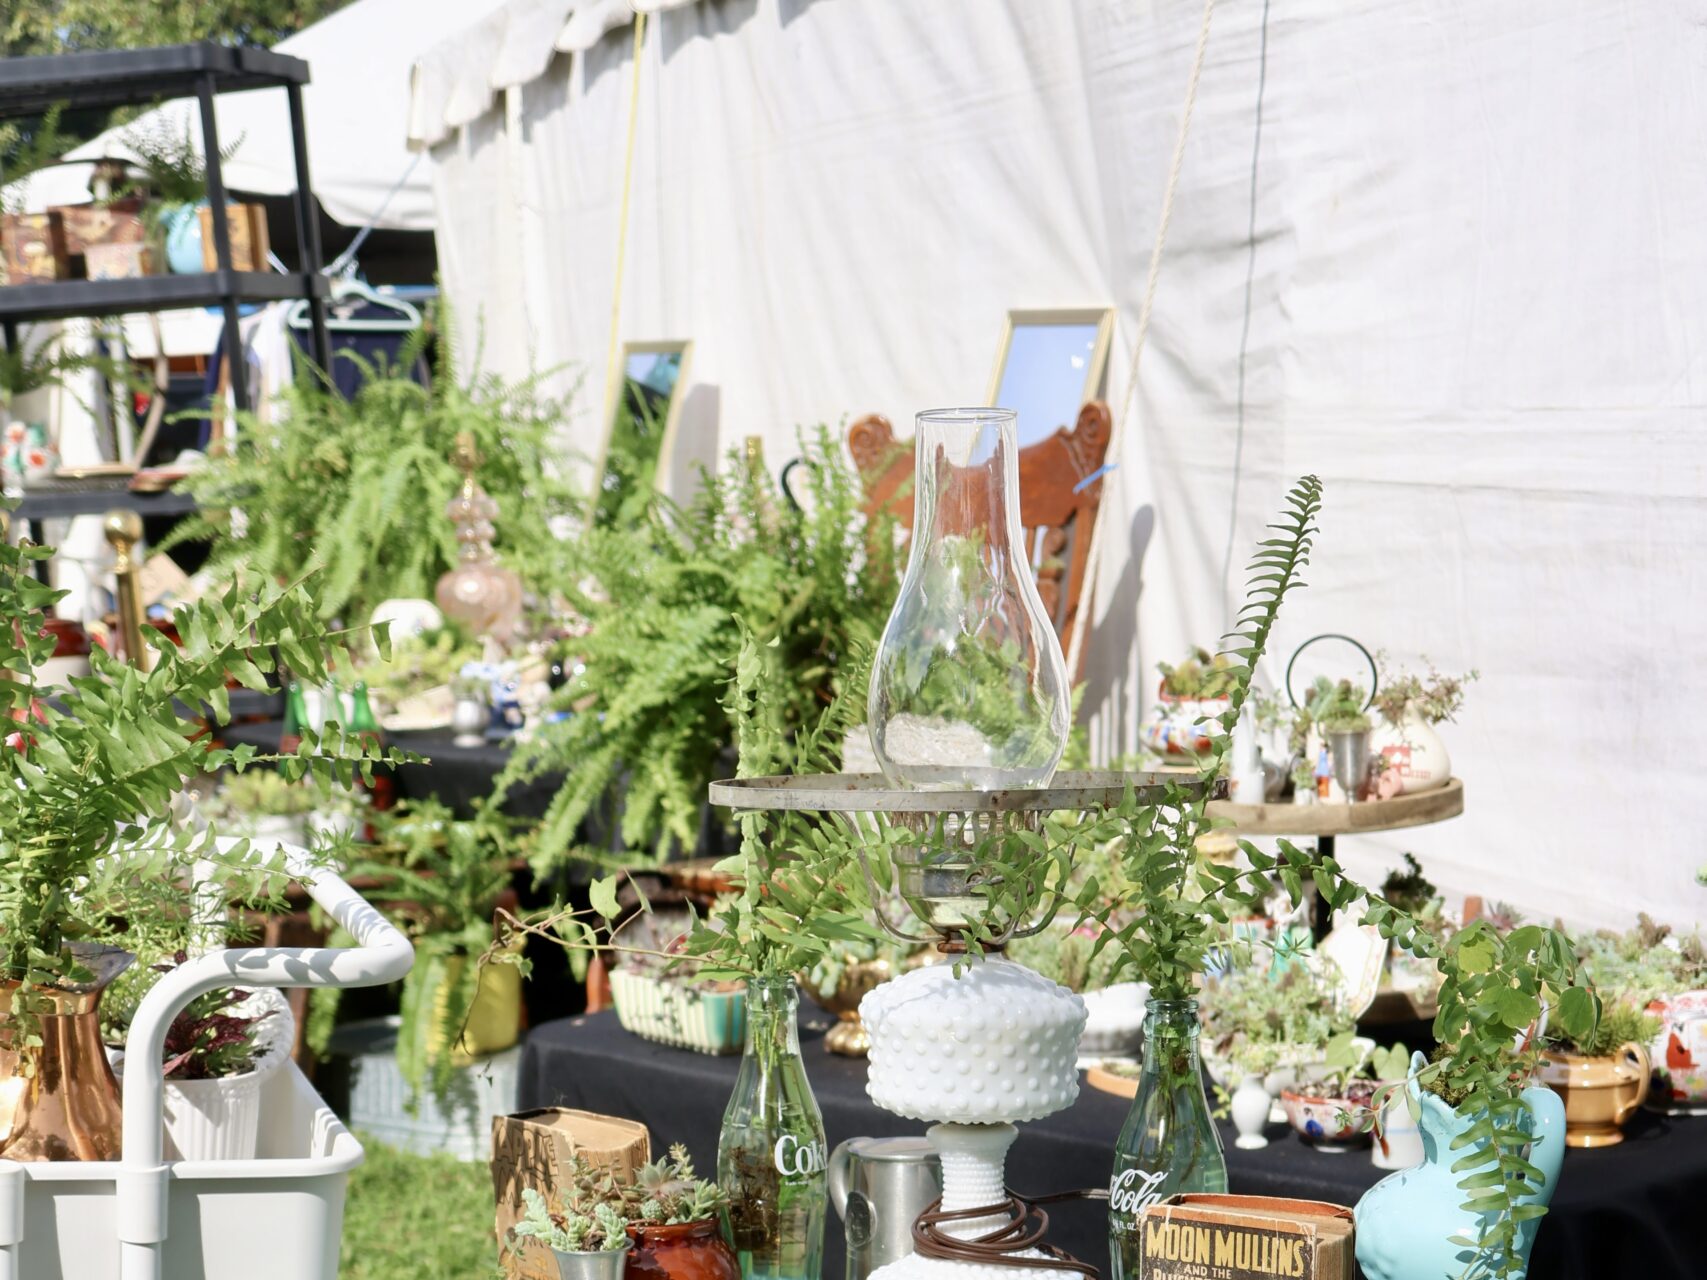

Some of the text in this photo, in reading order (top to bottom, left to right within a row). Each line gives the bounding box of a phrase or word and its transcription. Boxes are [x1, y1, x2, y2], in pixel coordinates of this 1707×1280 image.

[774, 1135, 828, 1176] Cok
[1111, 1168, 1169, 1215] Cola
[1146, 1221, 1305, 1277] MOON MULLINS
[1183, 1264, 1232, 1280] AND THE
